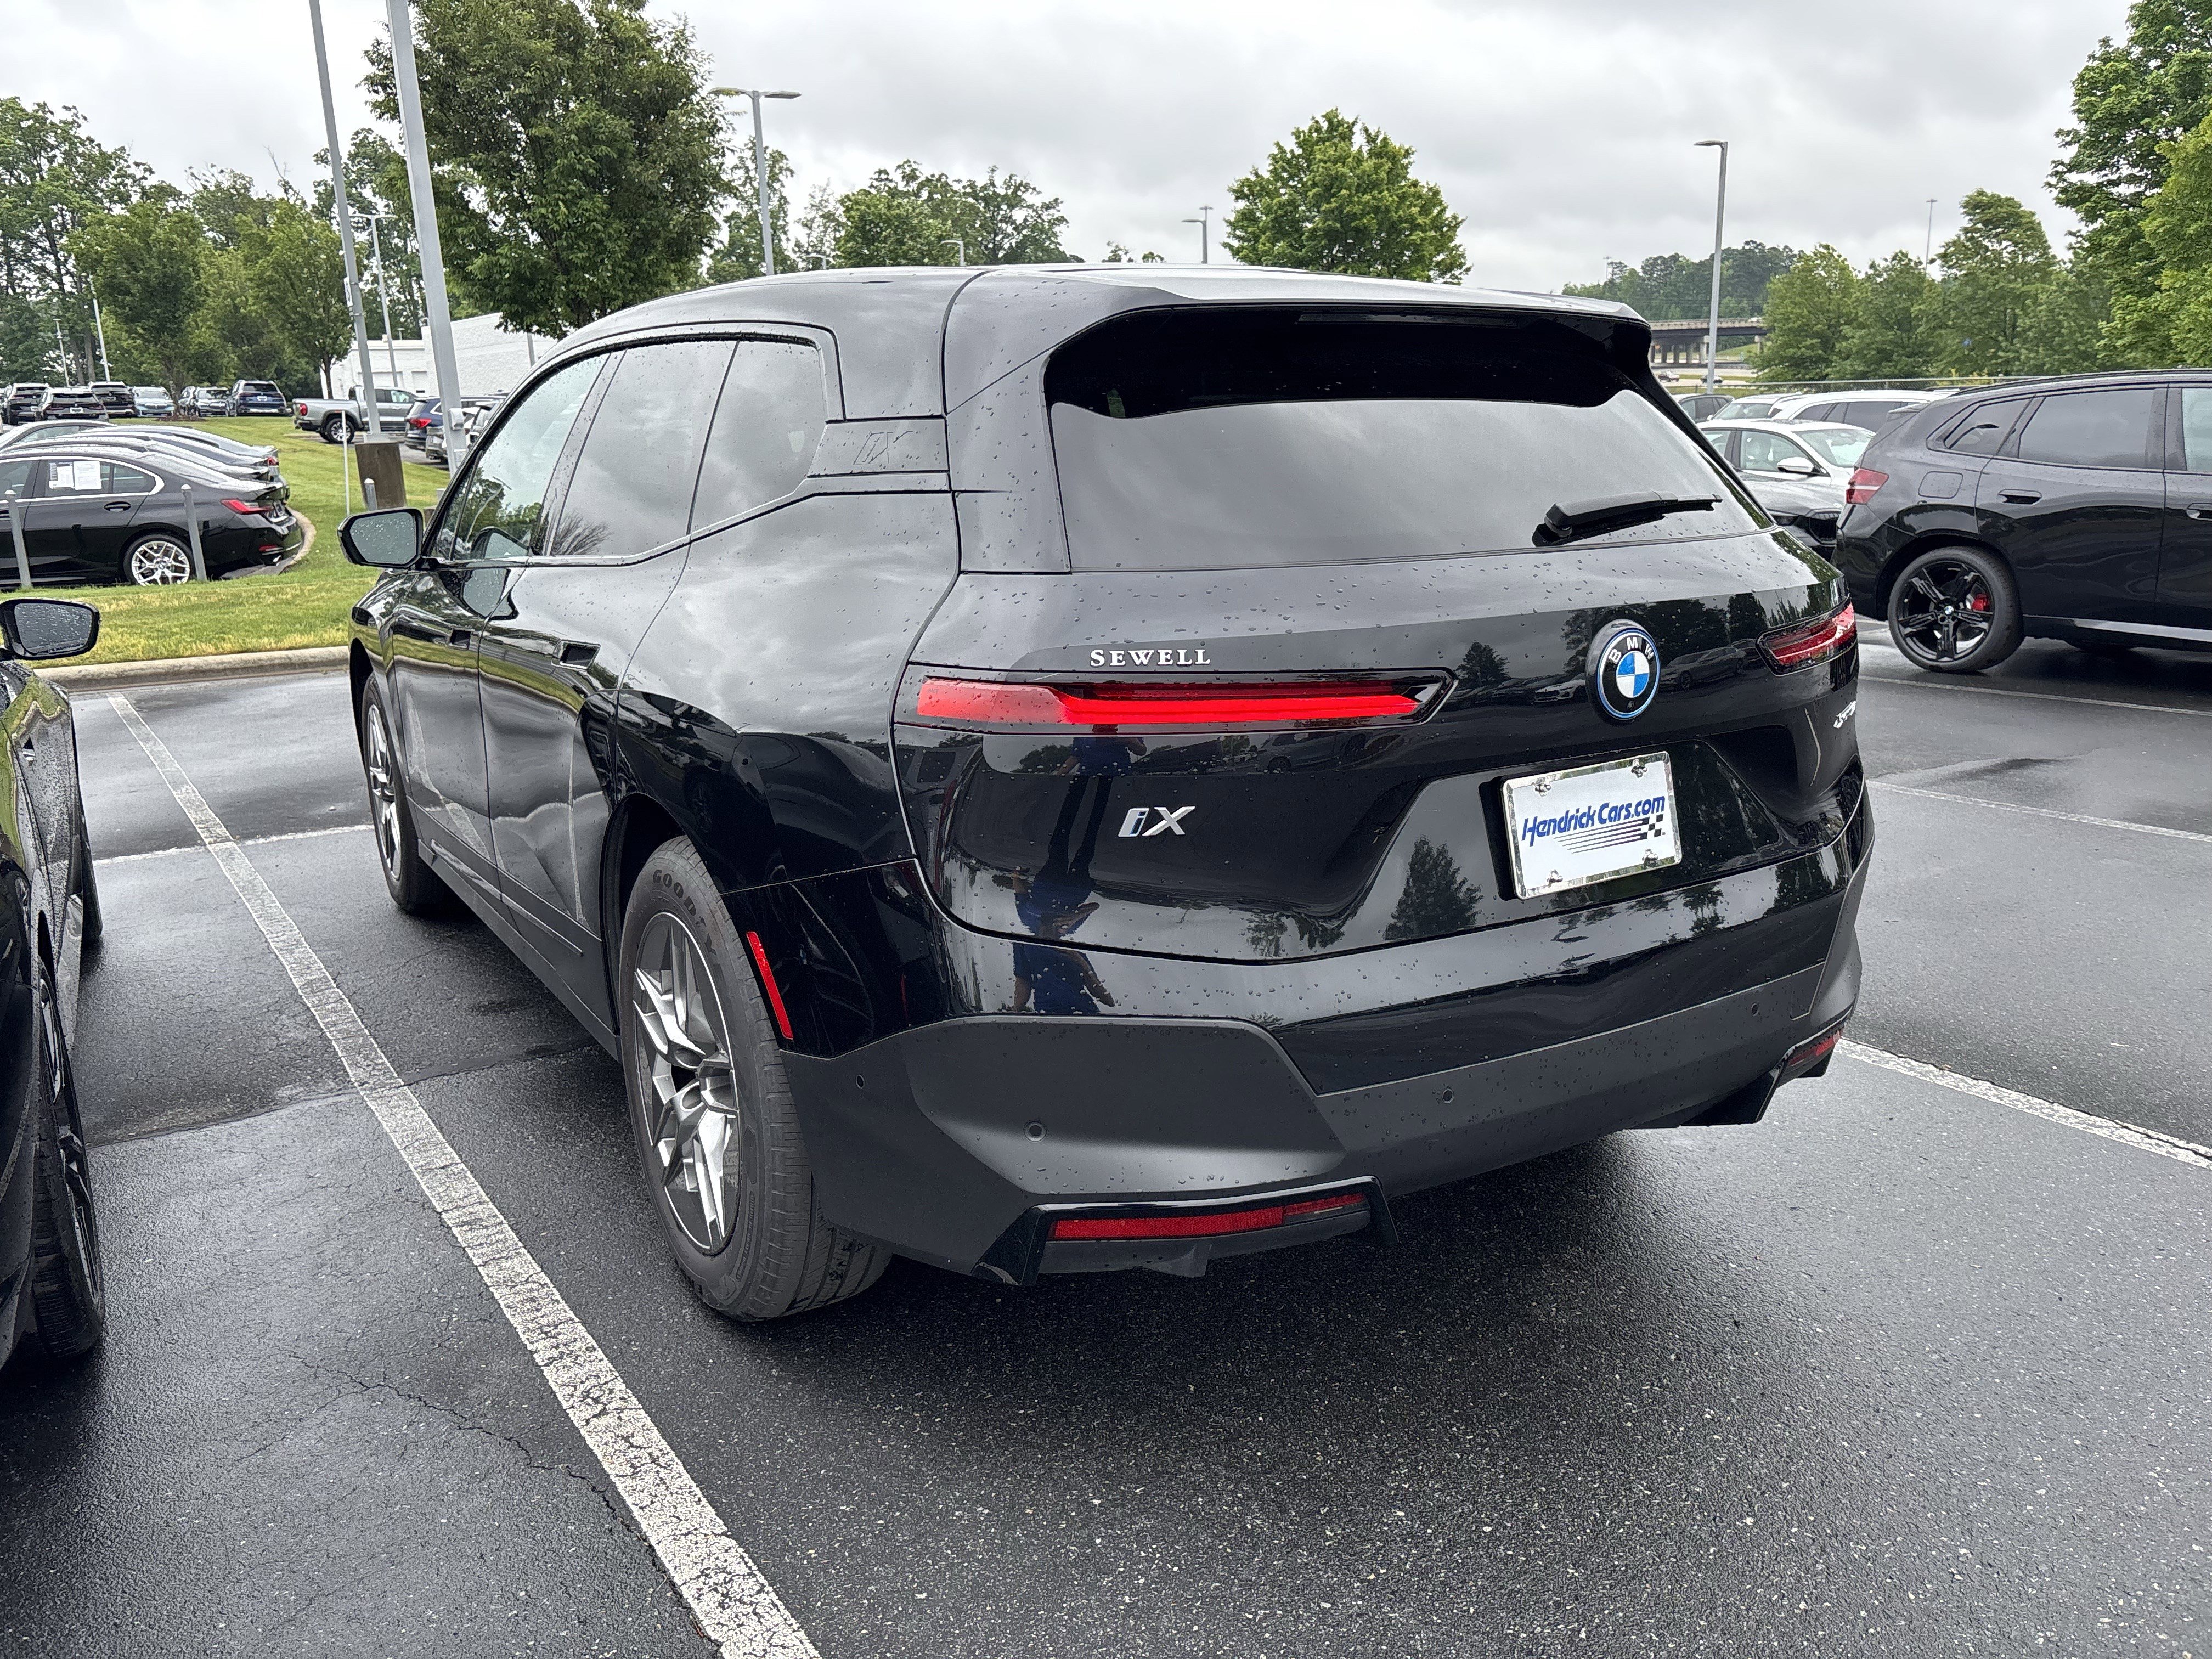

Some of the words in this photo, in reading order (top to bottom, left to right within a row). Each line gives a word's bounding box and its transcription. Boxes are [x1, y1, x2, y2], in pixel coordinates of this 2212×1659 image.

[1090, 648, 1211, 667] SEWELL
[1609, 636, 1654, 665] BMW
[1118, 805, 1195, 837] iX
